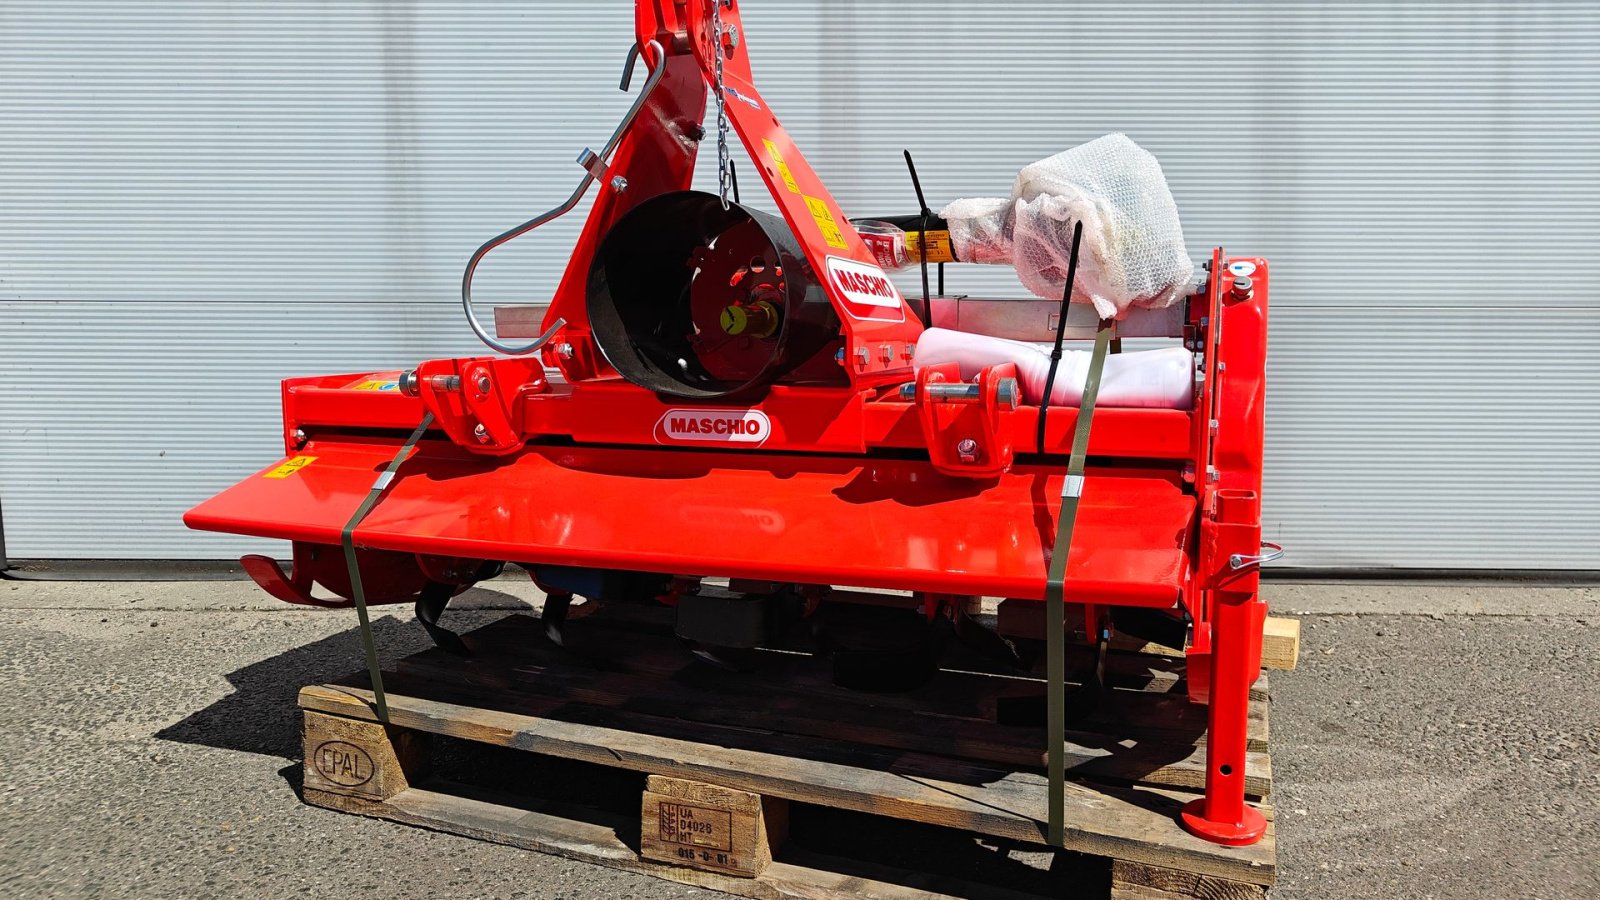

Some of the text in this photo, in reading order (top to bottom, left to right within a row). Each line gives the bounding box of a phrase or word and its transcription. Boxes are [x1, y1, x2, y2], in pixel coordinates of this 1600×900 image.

[833, 268, 895, 299] MASCHIO
[670, 417, 761, 435] MASCHIO
[322, 747, 365, 781] EPAL
[680, 808, 694, 819] UA
[680, 831, 693, 844] HT
